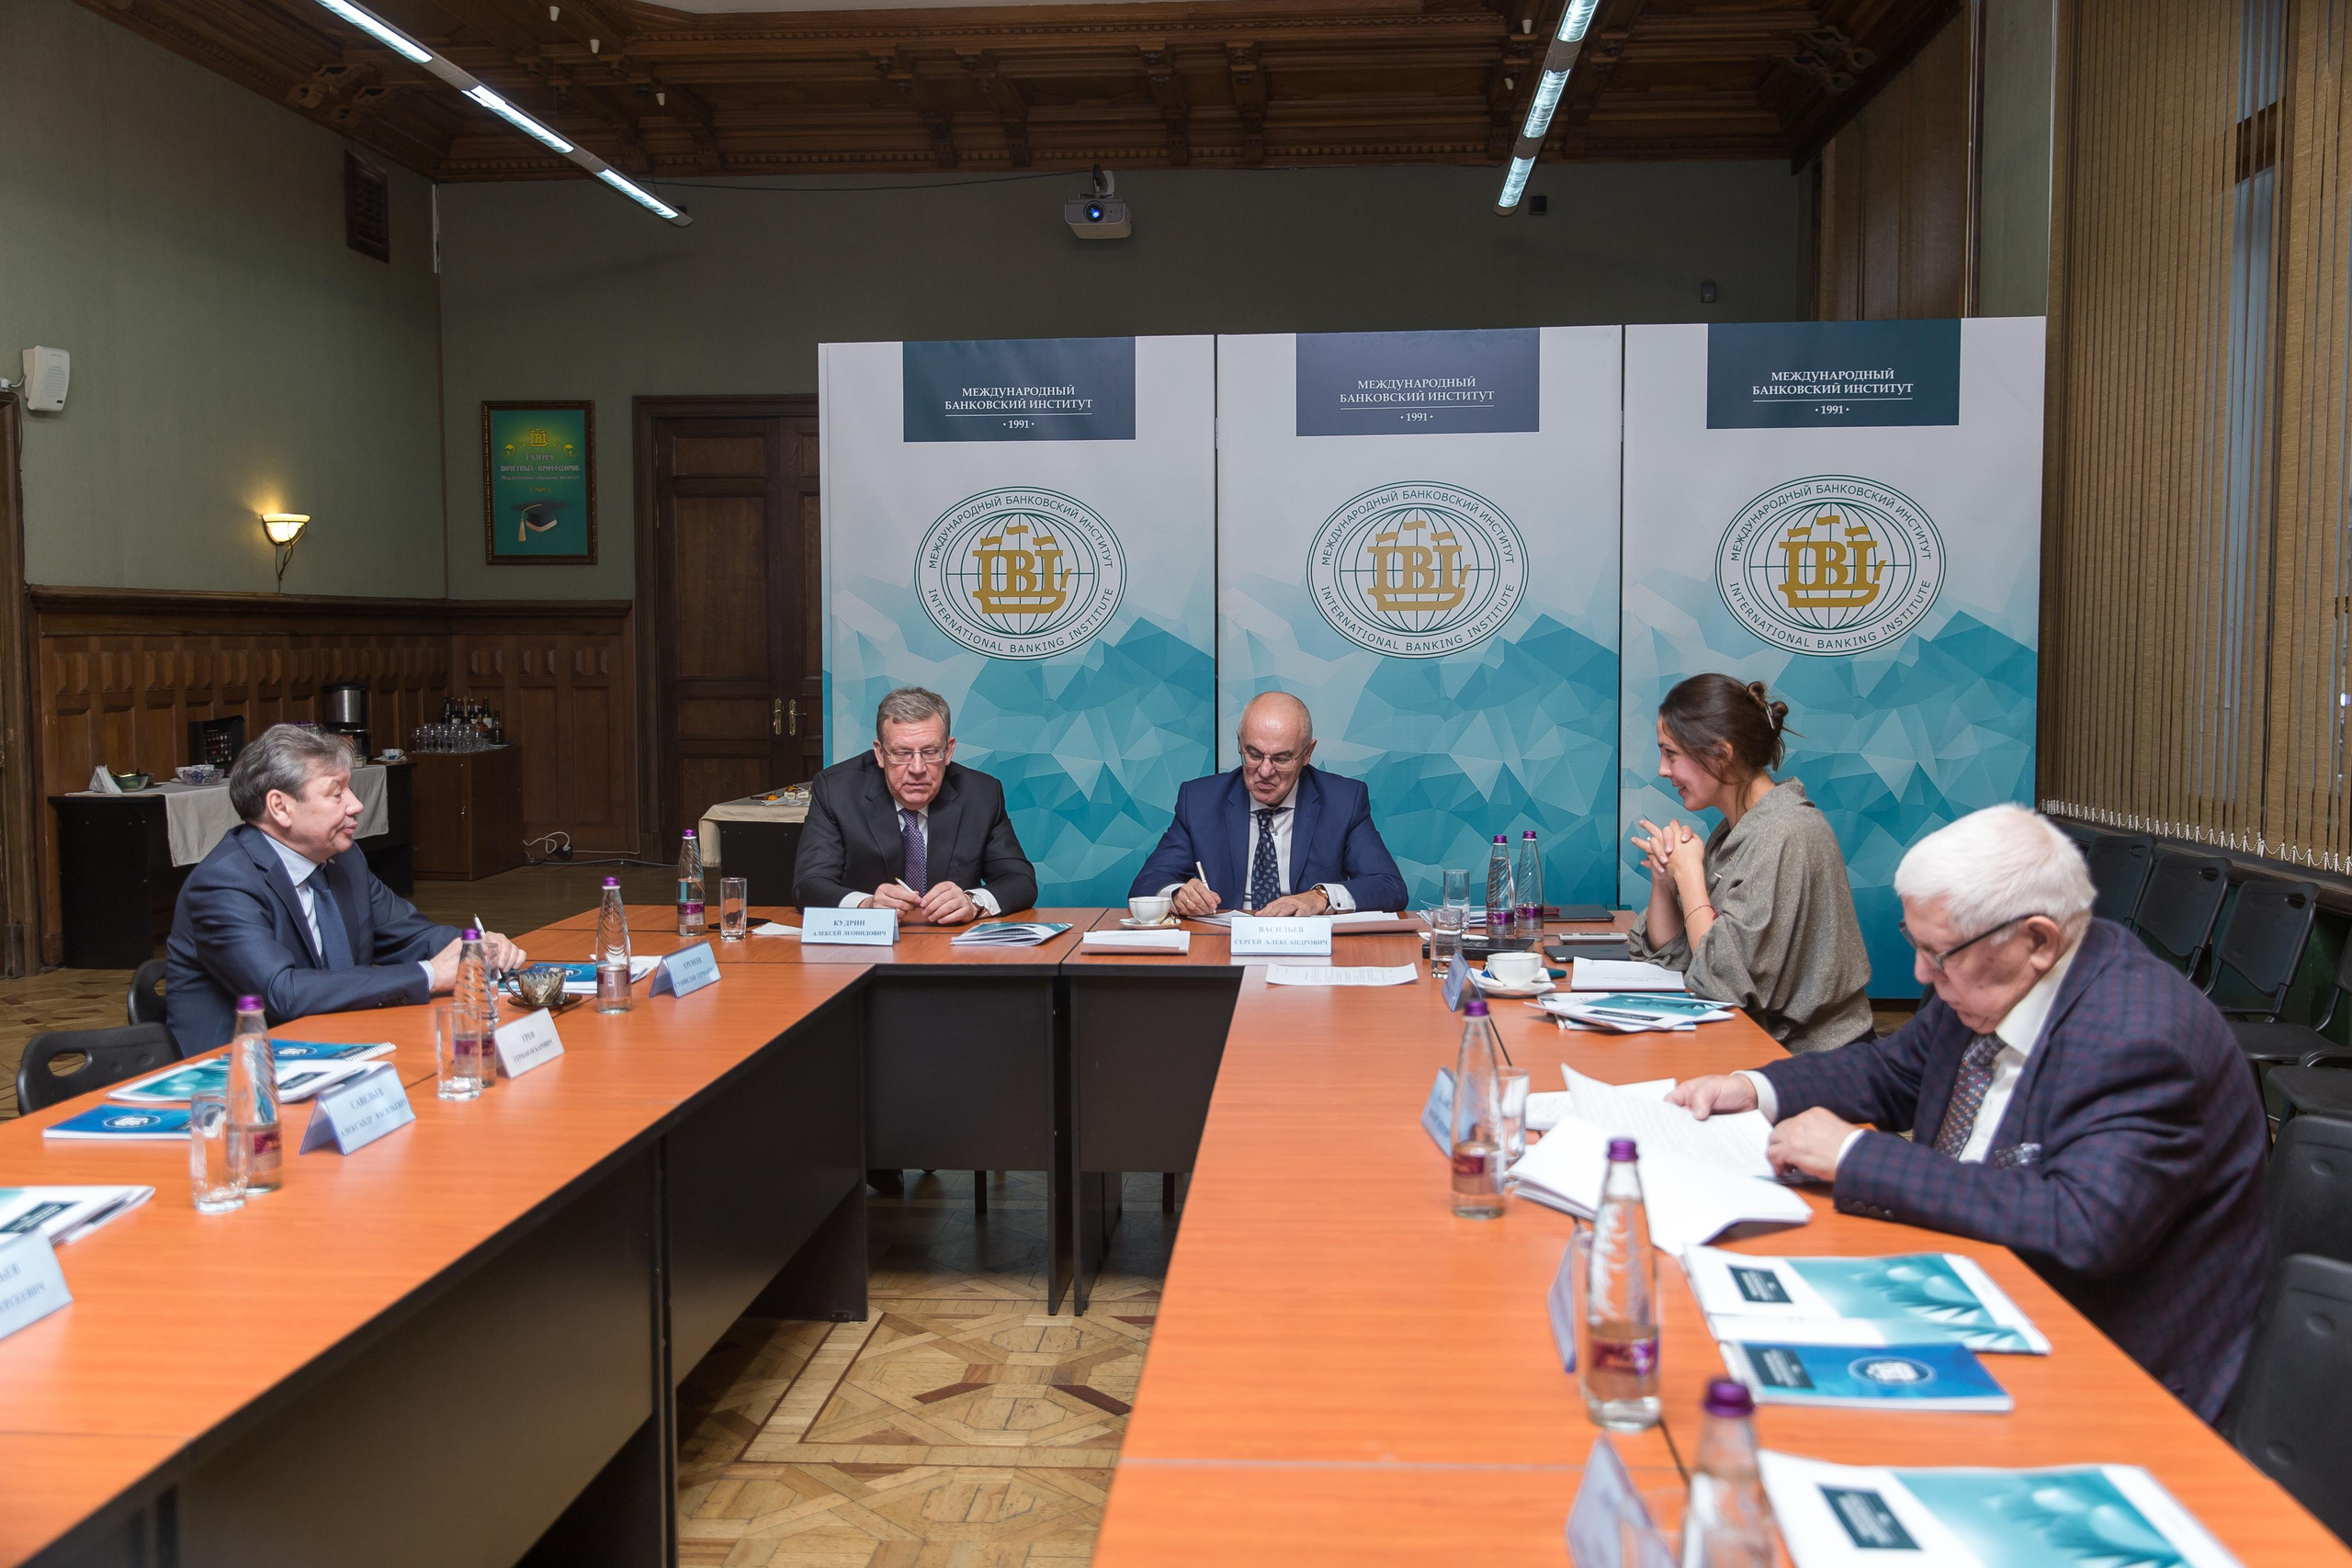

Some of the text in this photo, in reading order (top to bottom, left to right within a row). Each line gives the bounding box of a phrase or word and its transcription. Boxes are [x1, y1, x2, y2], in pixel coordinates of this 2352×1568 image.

[1770, 368, 1895, 383] МЕЖДУНАРОДНЫЙ
[1357, 376, 1476, 391] МЕЖДУНАРОДНЫЙ
[1752, 382, 1914, 396] БАНКОВСКИЙ ИНСТИТУТ
[961, 384, 1076, 399] МЕЖДУНАРОДНЫЙ
[1340, 389, 1495, 403] БАНКОВСКИЙ ИНСТИТУТ
[944, 398, 1093, 411] БАНКОВСКИЙ ИНСТИТУТ
[1821, 405, 1844, 415] 1991
[1008, 419, 1030, 429] 1991
[1406, 412, 1428, 423] 1991
[1321, 490, 1515, 566] МЕЖДУНАРОДНЫЙ БАНКОВСКИЙ ИНСТИТУТ
[1731, 484, 1931, 562] МЕЖДУНАРОДНЫЙ БАНКОВСКИЙ ИНСТИТУТ
[928, 495, 1114, 569] МЕЖДУНАРОДНЫЙ БАНКОВСКИЙ ИНСТИТУТ
[928, 587, 1114, 654] INTERNATIONAL BANKING INSTITUTE
[1321, 583, 1515, 651] INTERNATIONAL BANKING INSTITUTE
[1730, 580, 1931, 649] INTERNATIONAL BANKING INSTITUTE
